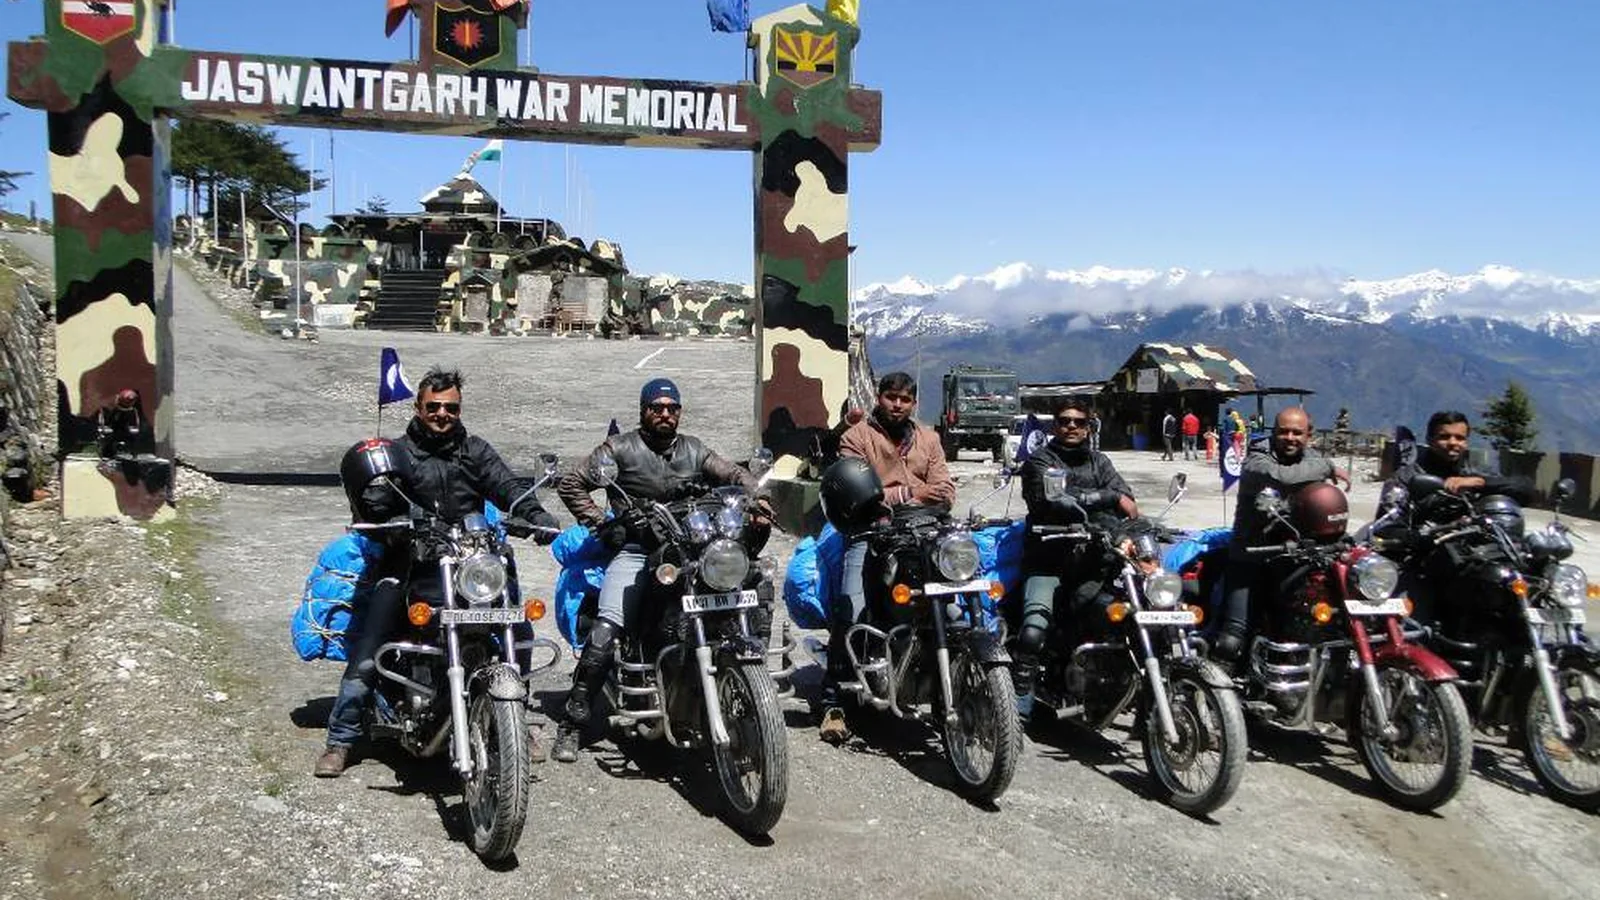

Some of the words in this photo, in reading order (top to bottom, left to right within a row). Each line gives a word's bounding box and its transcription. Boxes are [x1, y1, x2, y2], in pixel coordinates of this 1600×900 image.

[181, 59, 486, 118] JASWANTGARH
[496, 77, 571, 122] WAR
[579, 83, 748, 133] MEMORIAL
